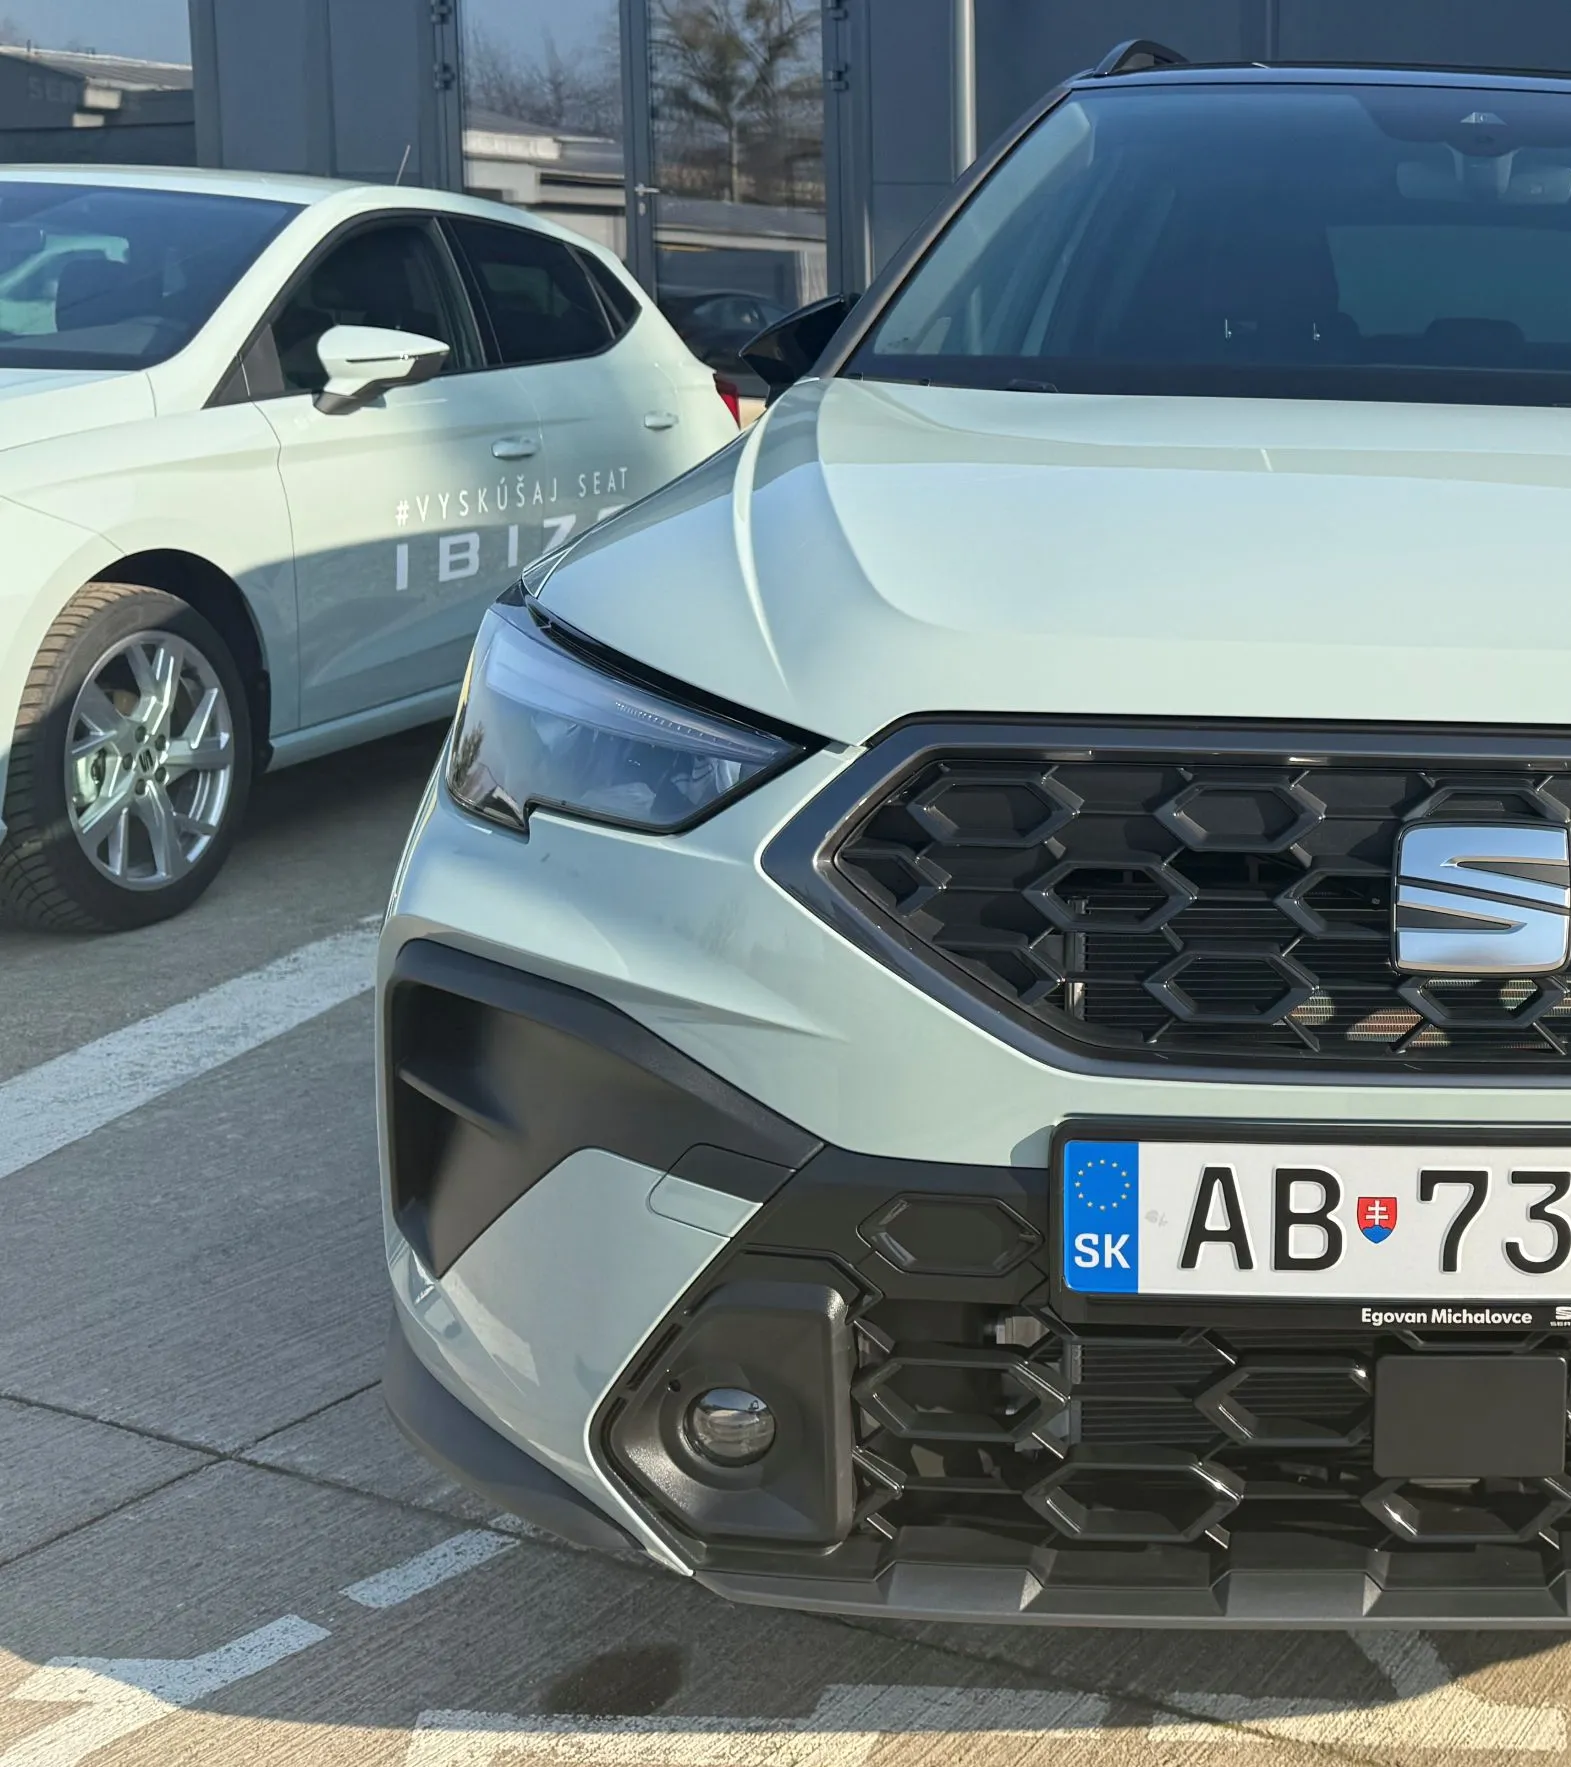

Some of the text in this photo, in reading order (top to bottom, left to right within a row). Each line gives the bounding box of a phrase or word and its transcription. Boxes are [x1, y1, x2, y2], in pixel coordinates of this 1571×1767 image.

[395, 467, 628, 527] #VYSKÚŠAJ SEAT
[396, 504, 629, 591] IBIZ
[1180, 1166, 1343, 1271] AB
[1074, 1233, 1130, 1269] SK
[1361, 1307, 1533, 1327] Egovan Michalovce
